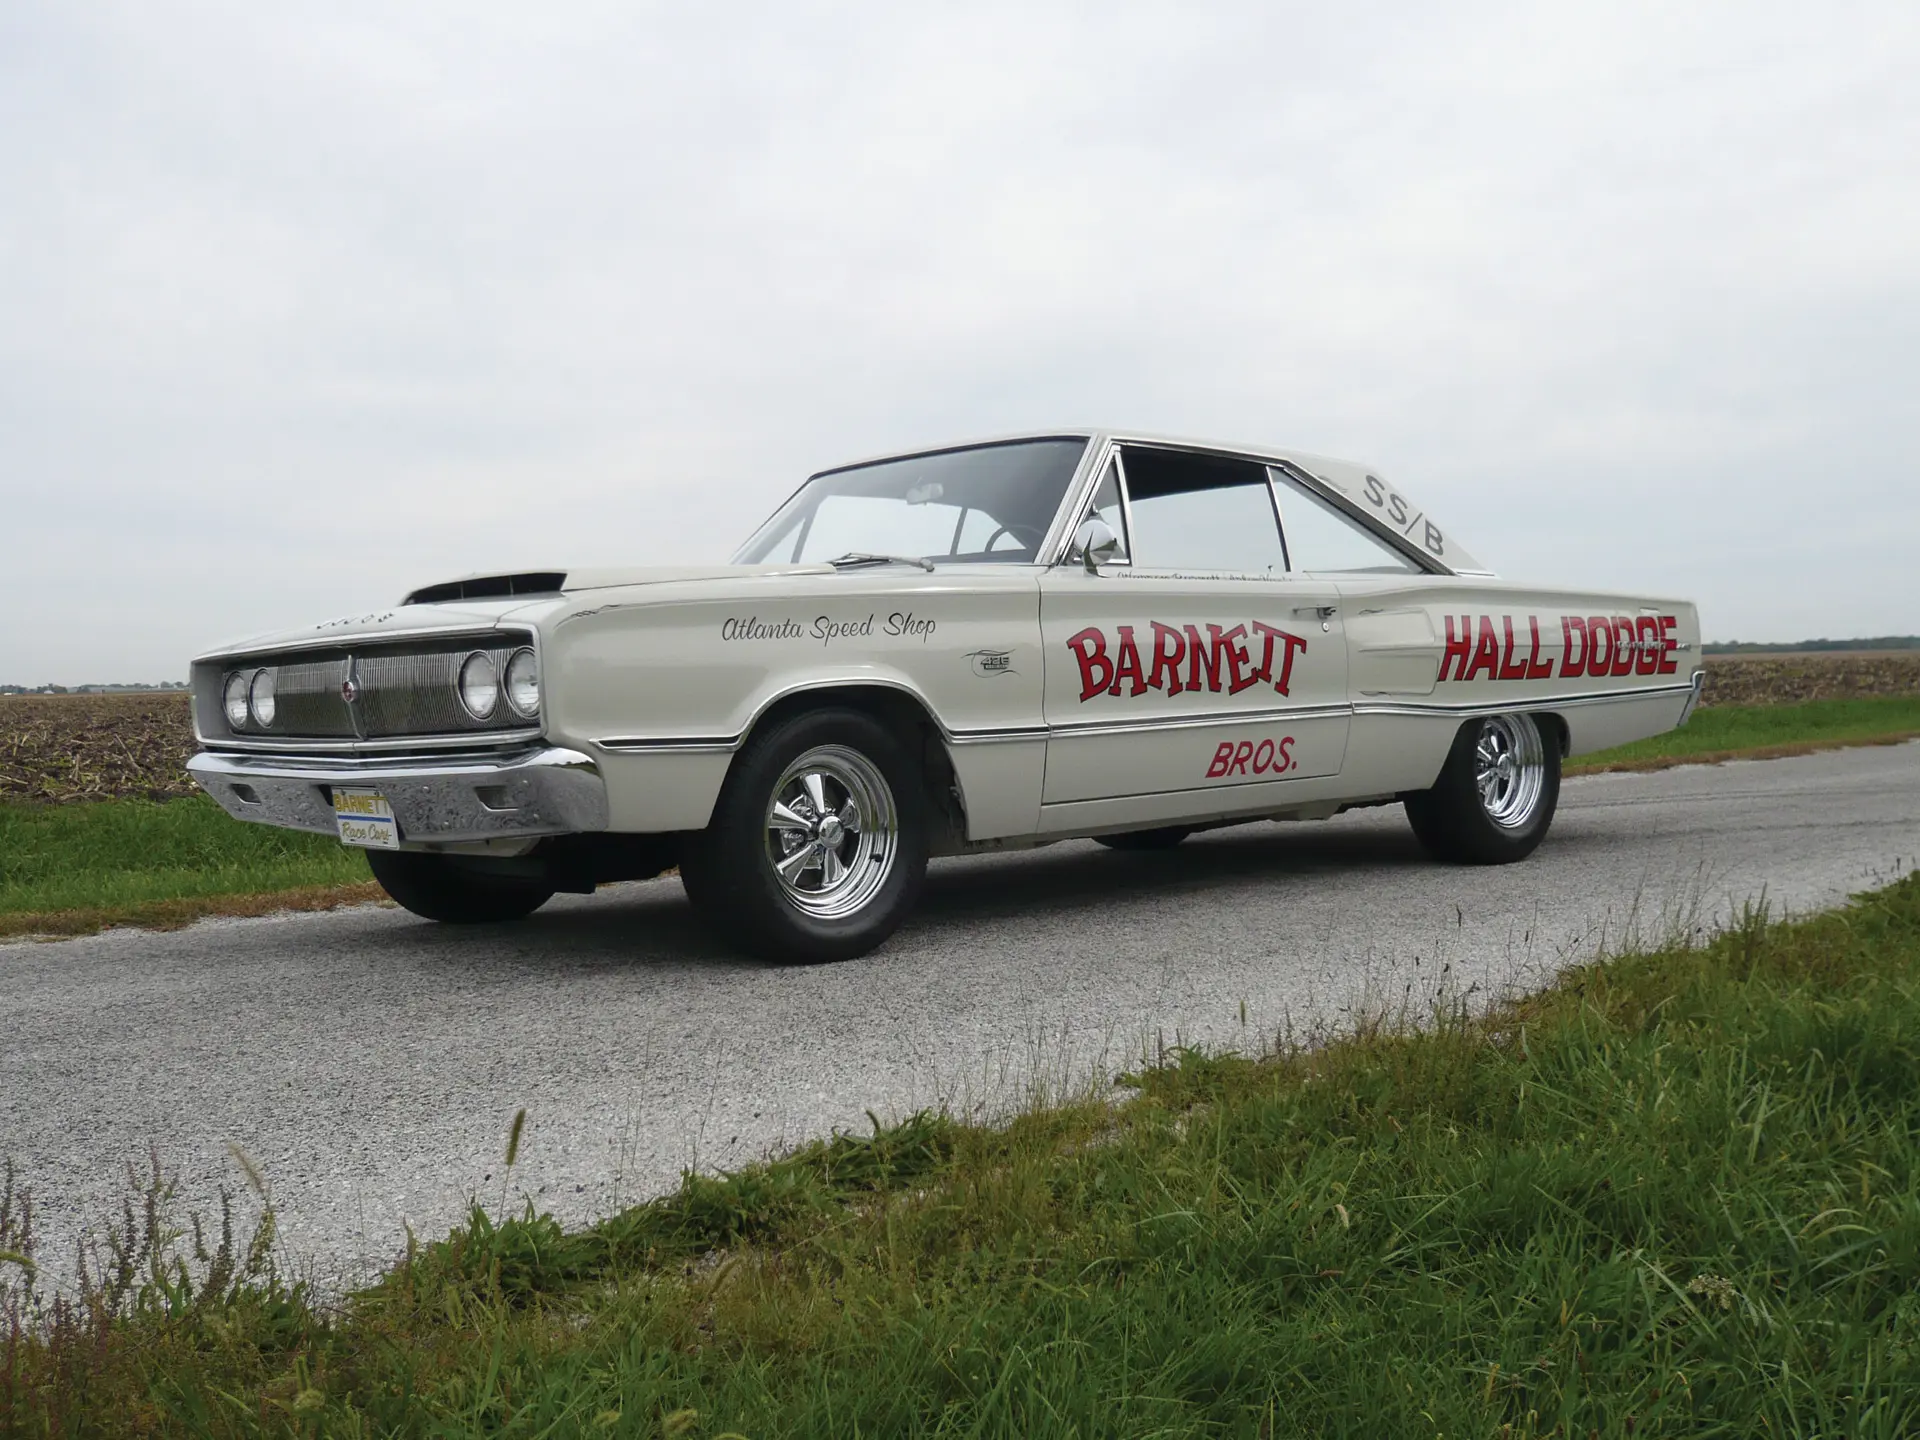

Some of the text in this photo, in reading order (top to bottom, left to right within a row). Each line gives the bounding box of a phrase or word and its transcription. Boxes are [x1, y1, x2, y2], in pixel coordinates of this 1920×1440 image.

[1363, 474, 1444, 556] SS/B
[721, 612, 936, 647] Atlanta Speed Shop
[1437, 615, 1678, 682] HALL DODGE
[1066, 620, 1307, 703] BARNETT
[1205, 736, 1297, 778] BROS.
[333, 793, 389, 815] BARNETT
